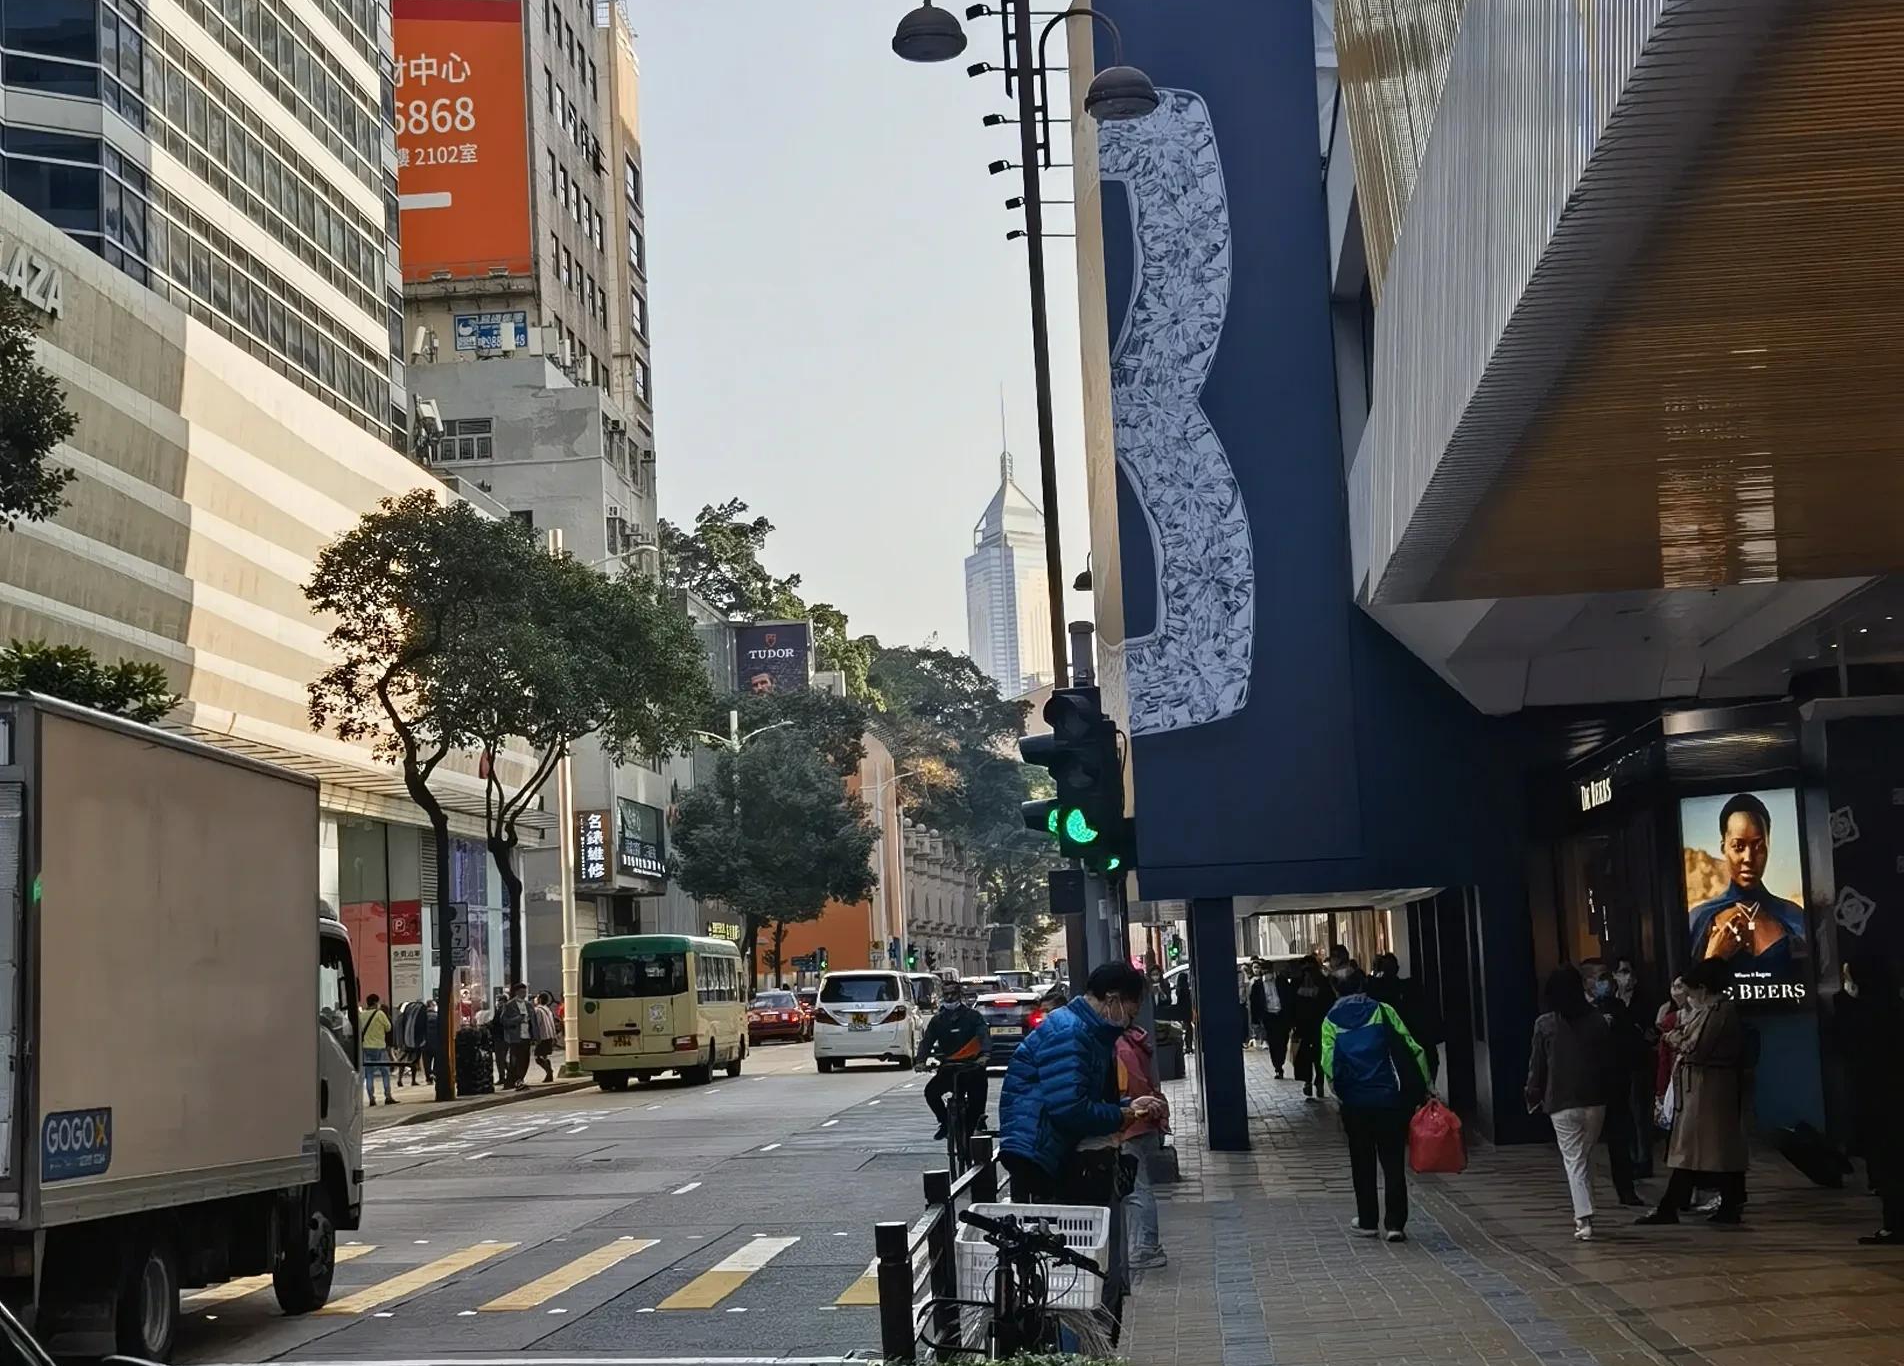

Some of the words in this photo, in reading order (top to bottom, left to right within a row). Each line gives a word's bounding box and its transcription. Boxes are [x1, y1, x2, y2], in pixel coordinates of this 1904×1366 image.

[414, 142, 479, 167] 2102室
[748, 648, 795, 660] TUDOR
[1738, 983, 1806, 1000] BEERS
[47, 1115, 108, 1153] GOGOX
